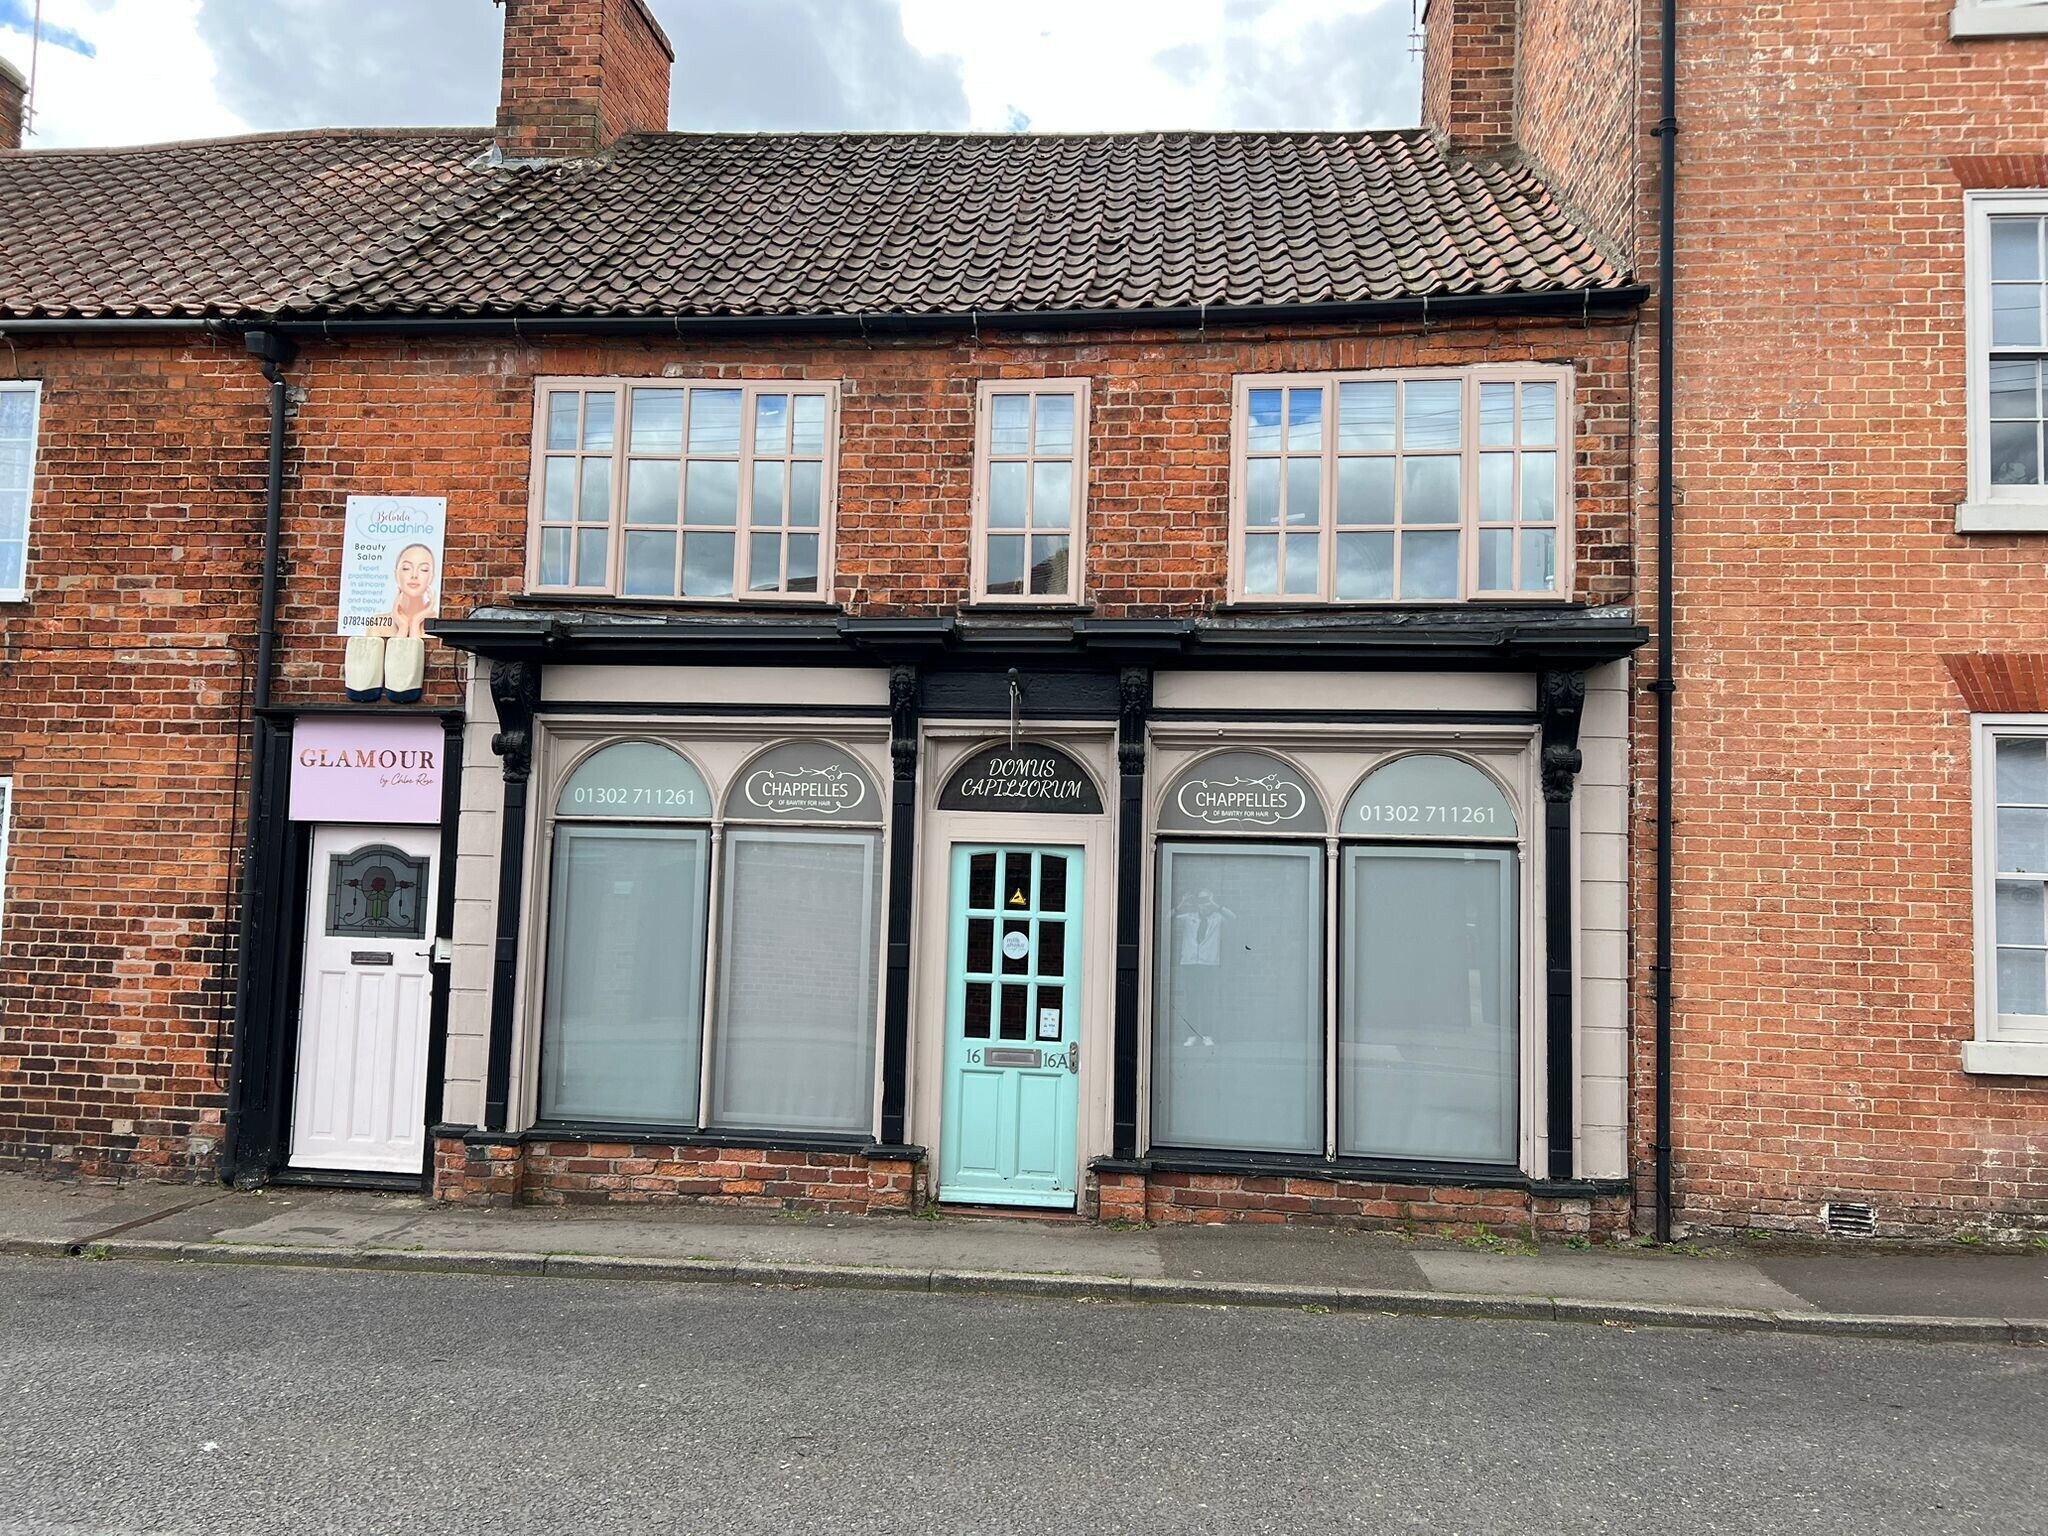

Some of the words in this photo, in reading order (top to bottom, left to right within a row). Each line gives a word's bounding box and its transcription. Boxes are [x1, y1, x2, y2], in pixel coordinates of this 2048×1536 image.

[378, 511, 410, 523] Belinda
[368, 522, 434, 534] cloudnine
[354, 543, 387, 553] Beauty
[357, 553, 383, 561] Salon
[343, 616, 393, 627] 07824664720
[299, 748, 435, 769] GLAMOUR
[989, 758, 1056, 778] DOMUS
[380, 774, 389, 788] by
[416, 772, 434, 786] Rose
[574, 787, 627, 805] 01302
[632, 788, 695, 806] 711261
[762, 781, 848, 798] CHAPPELLES
[961, 778, 1082, 799] CAPILLORUM
[1195, 791, 1288, 808] CHAPPELLES
[1360, 805, 1419, 823] 01302
[1425, 806, 1495, 824] 711261
[966, 1048, 981, 1064] 16
[1043, 1053, 1069, 1069] 16A
